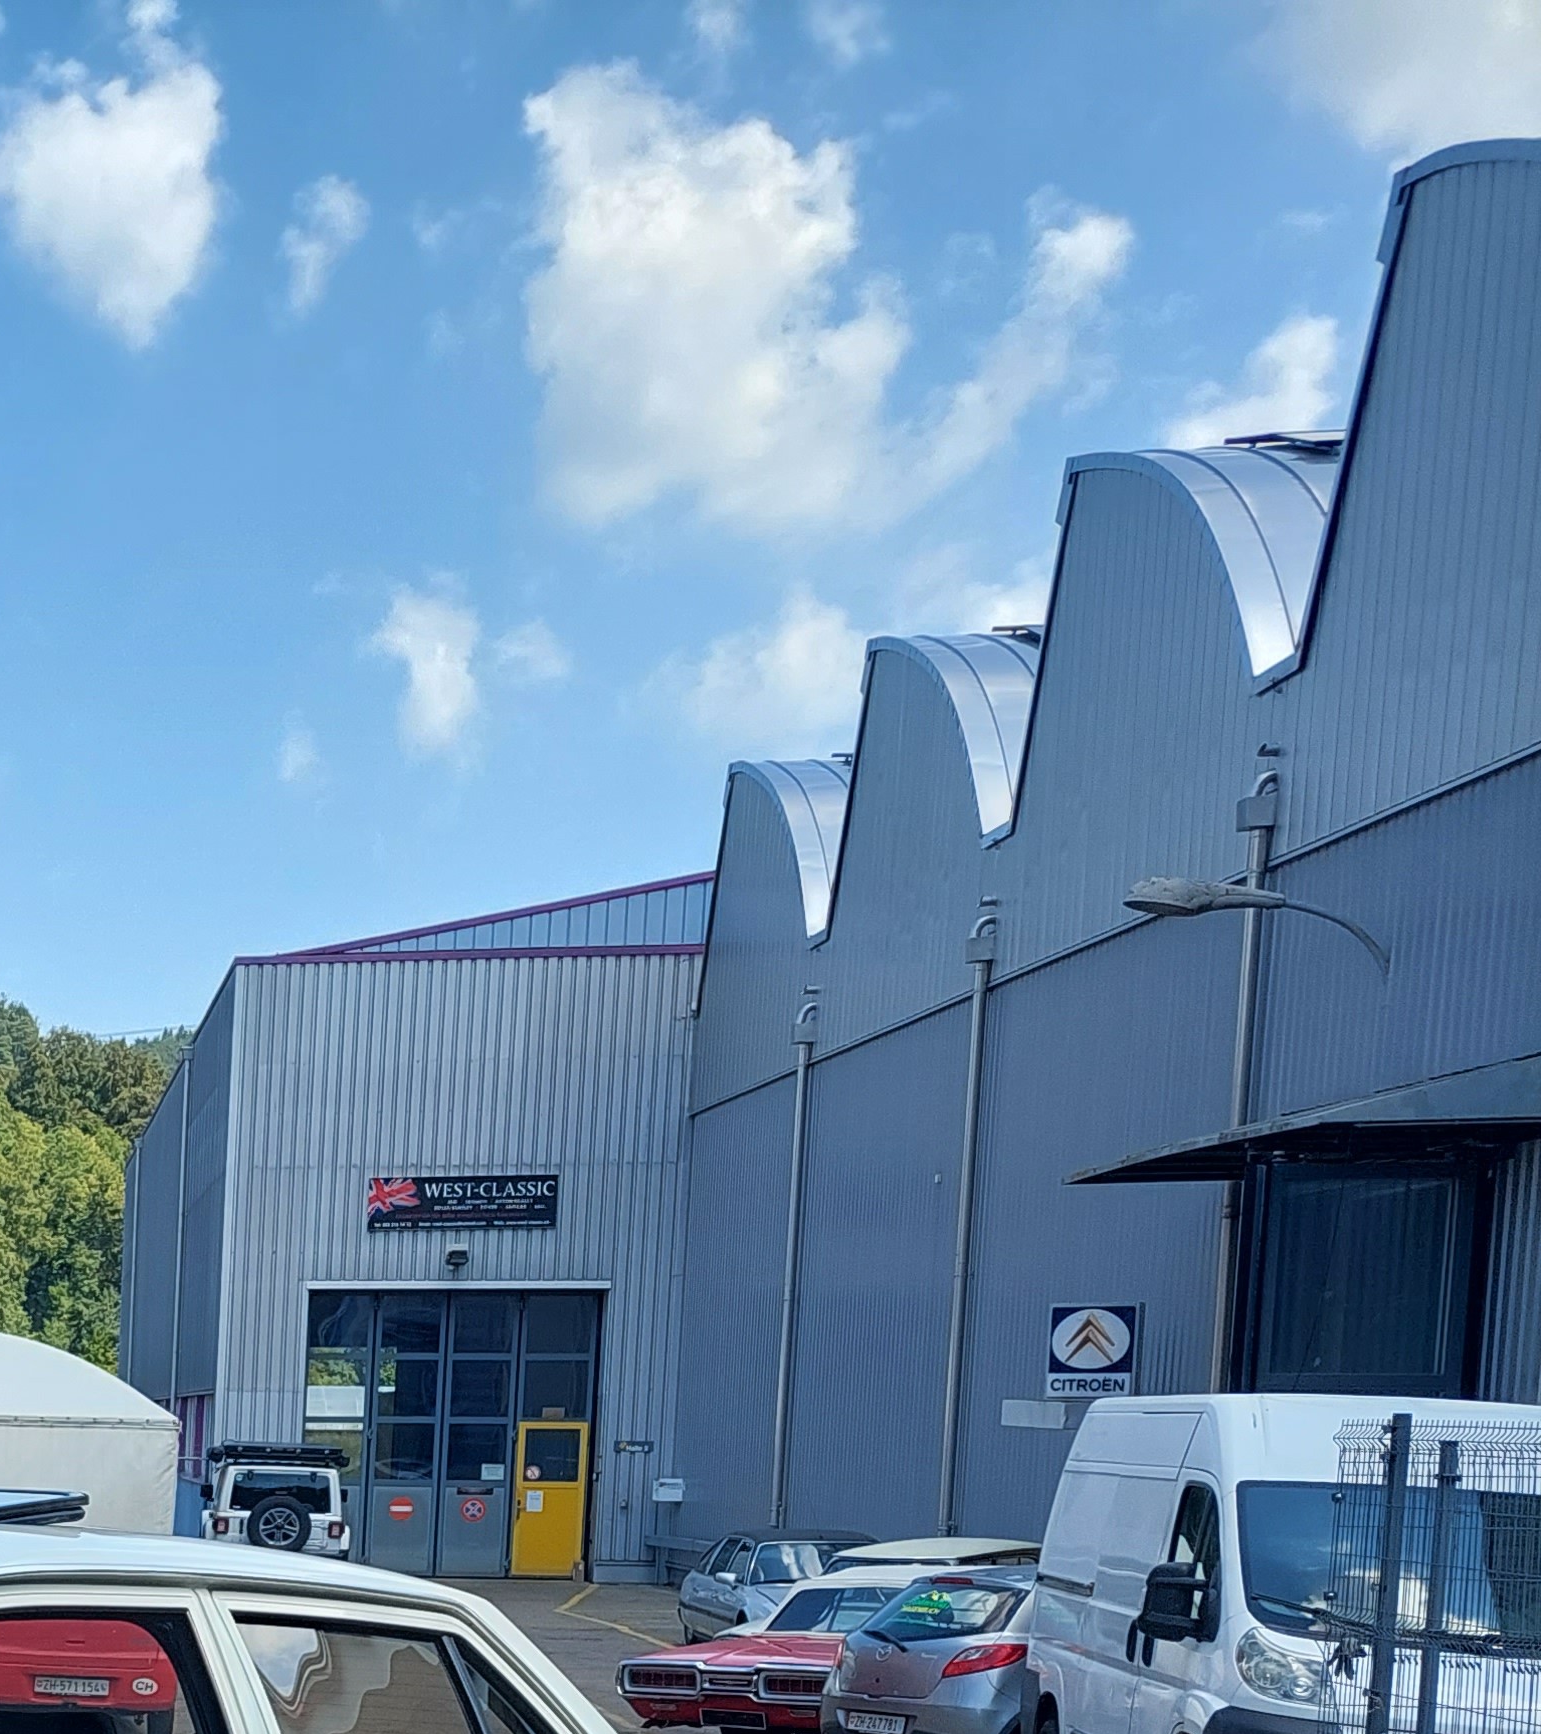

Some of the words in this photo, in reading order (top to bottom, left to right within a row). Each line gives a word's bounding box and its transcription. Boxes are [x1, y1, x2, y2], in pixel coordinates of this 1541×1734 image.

[424, 1181, 556, 1198] WEST-CLASSIC
[1050, 1376, 1126, 1393] CITROËN
[135, 1681, 155, 1692] CH
